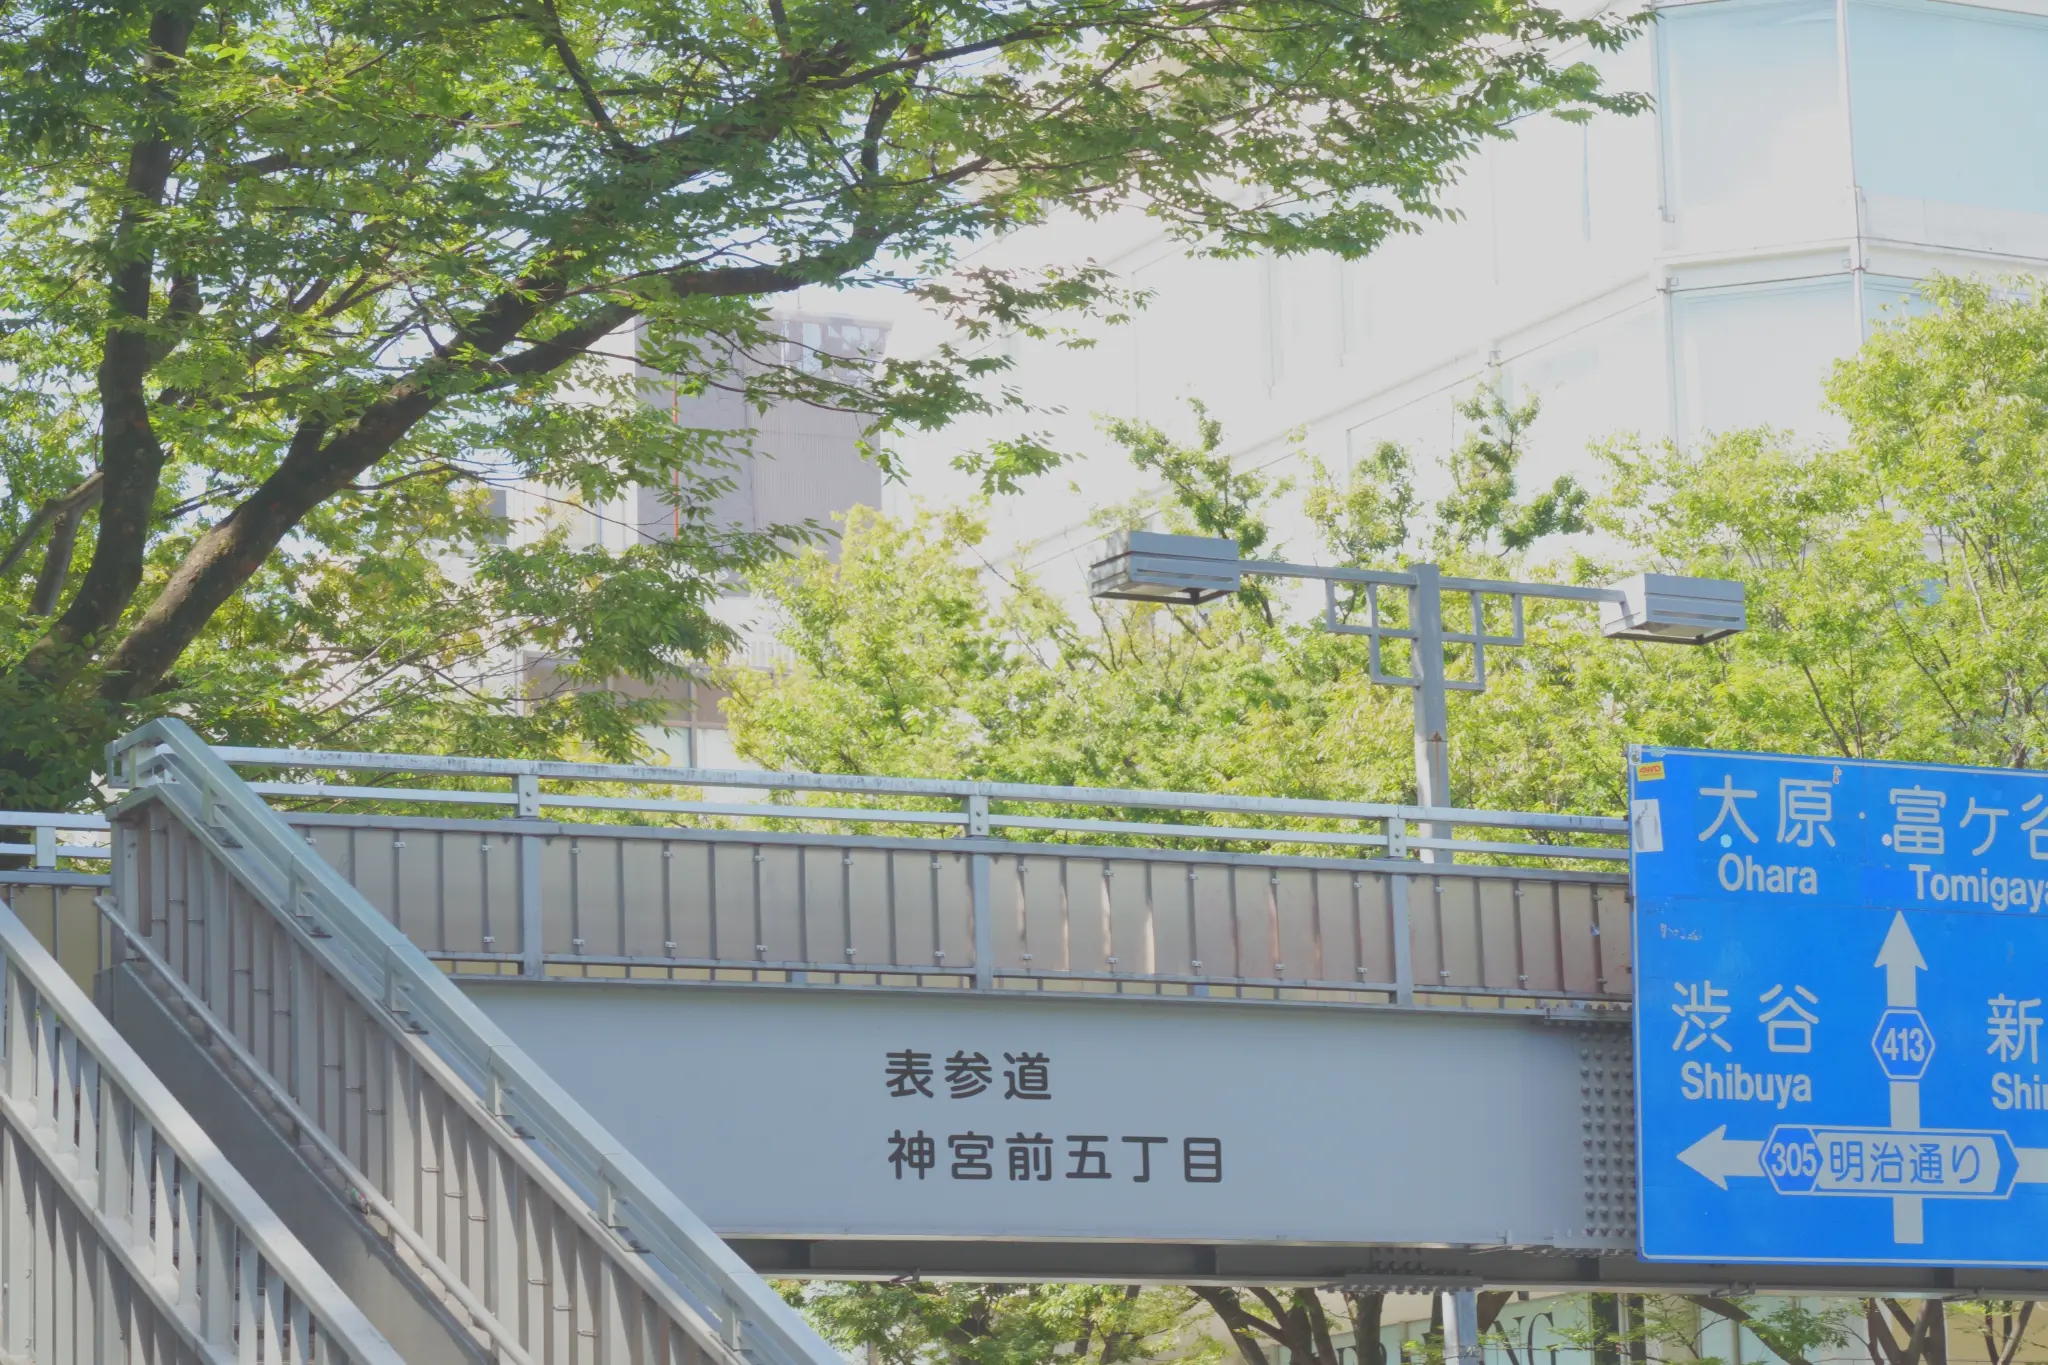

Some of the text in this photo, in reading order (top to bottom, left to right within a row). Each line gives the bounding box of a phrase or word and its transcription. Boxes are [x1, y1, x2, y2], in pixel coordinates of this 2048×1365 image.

[1718, 853, 2048, 913] Ohara Tomigay
[1672, 980, 1819, 1054] 渋谷
[1987, 993, 2044, 1064] 新
[1882, 1027, 1925, 1062] 413
[885, 1049, 1052, 1100] 表参道
[1681, 1061, 1812, 1110] Shibuya
[888, 1129, 1222, 1183] 神宮前五丁目
[1771, 1139, 1980, 1184] 305 明治通り
